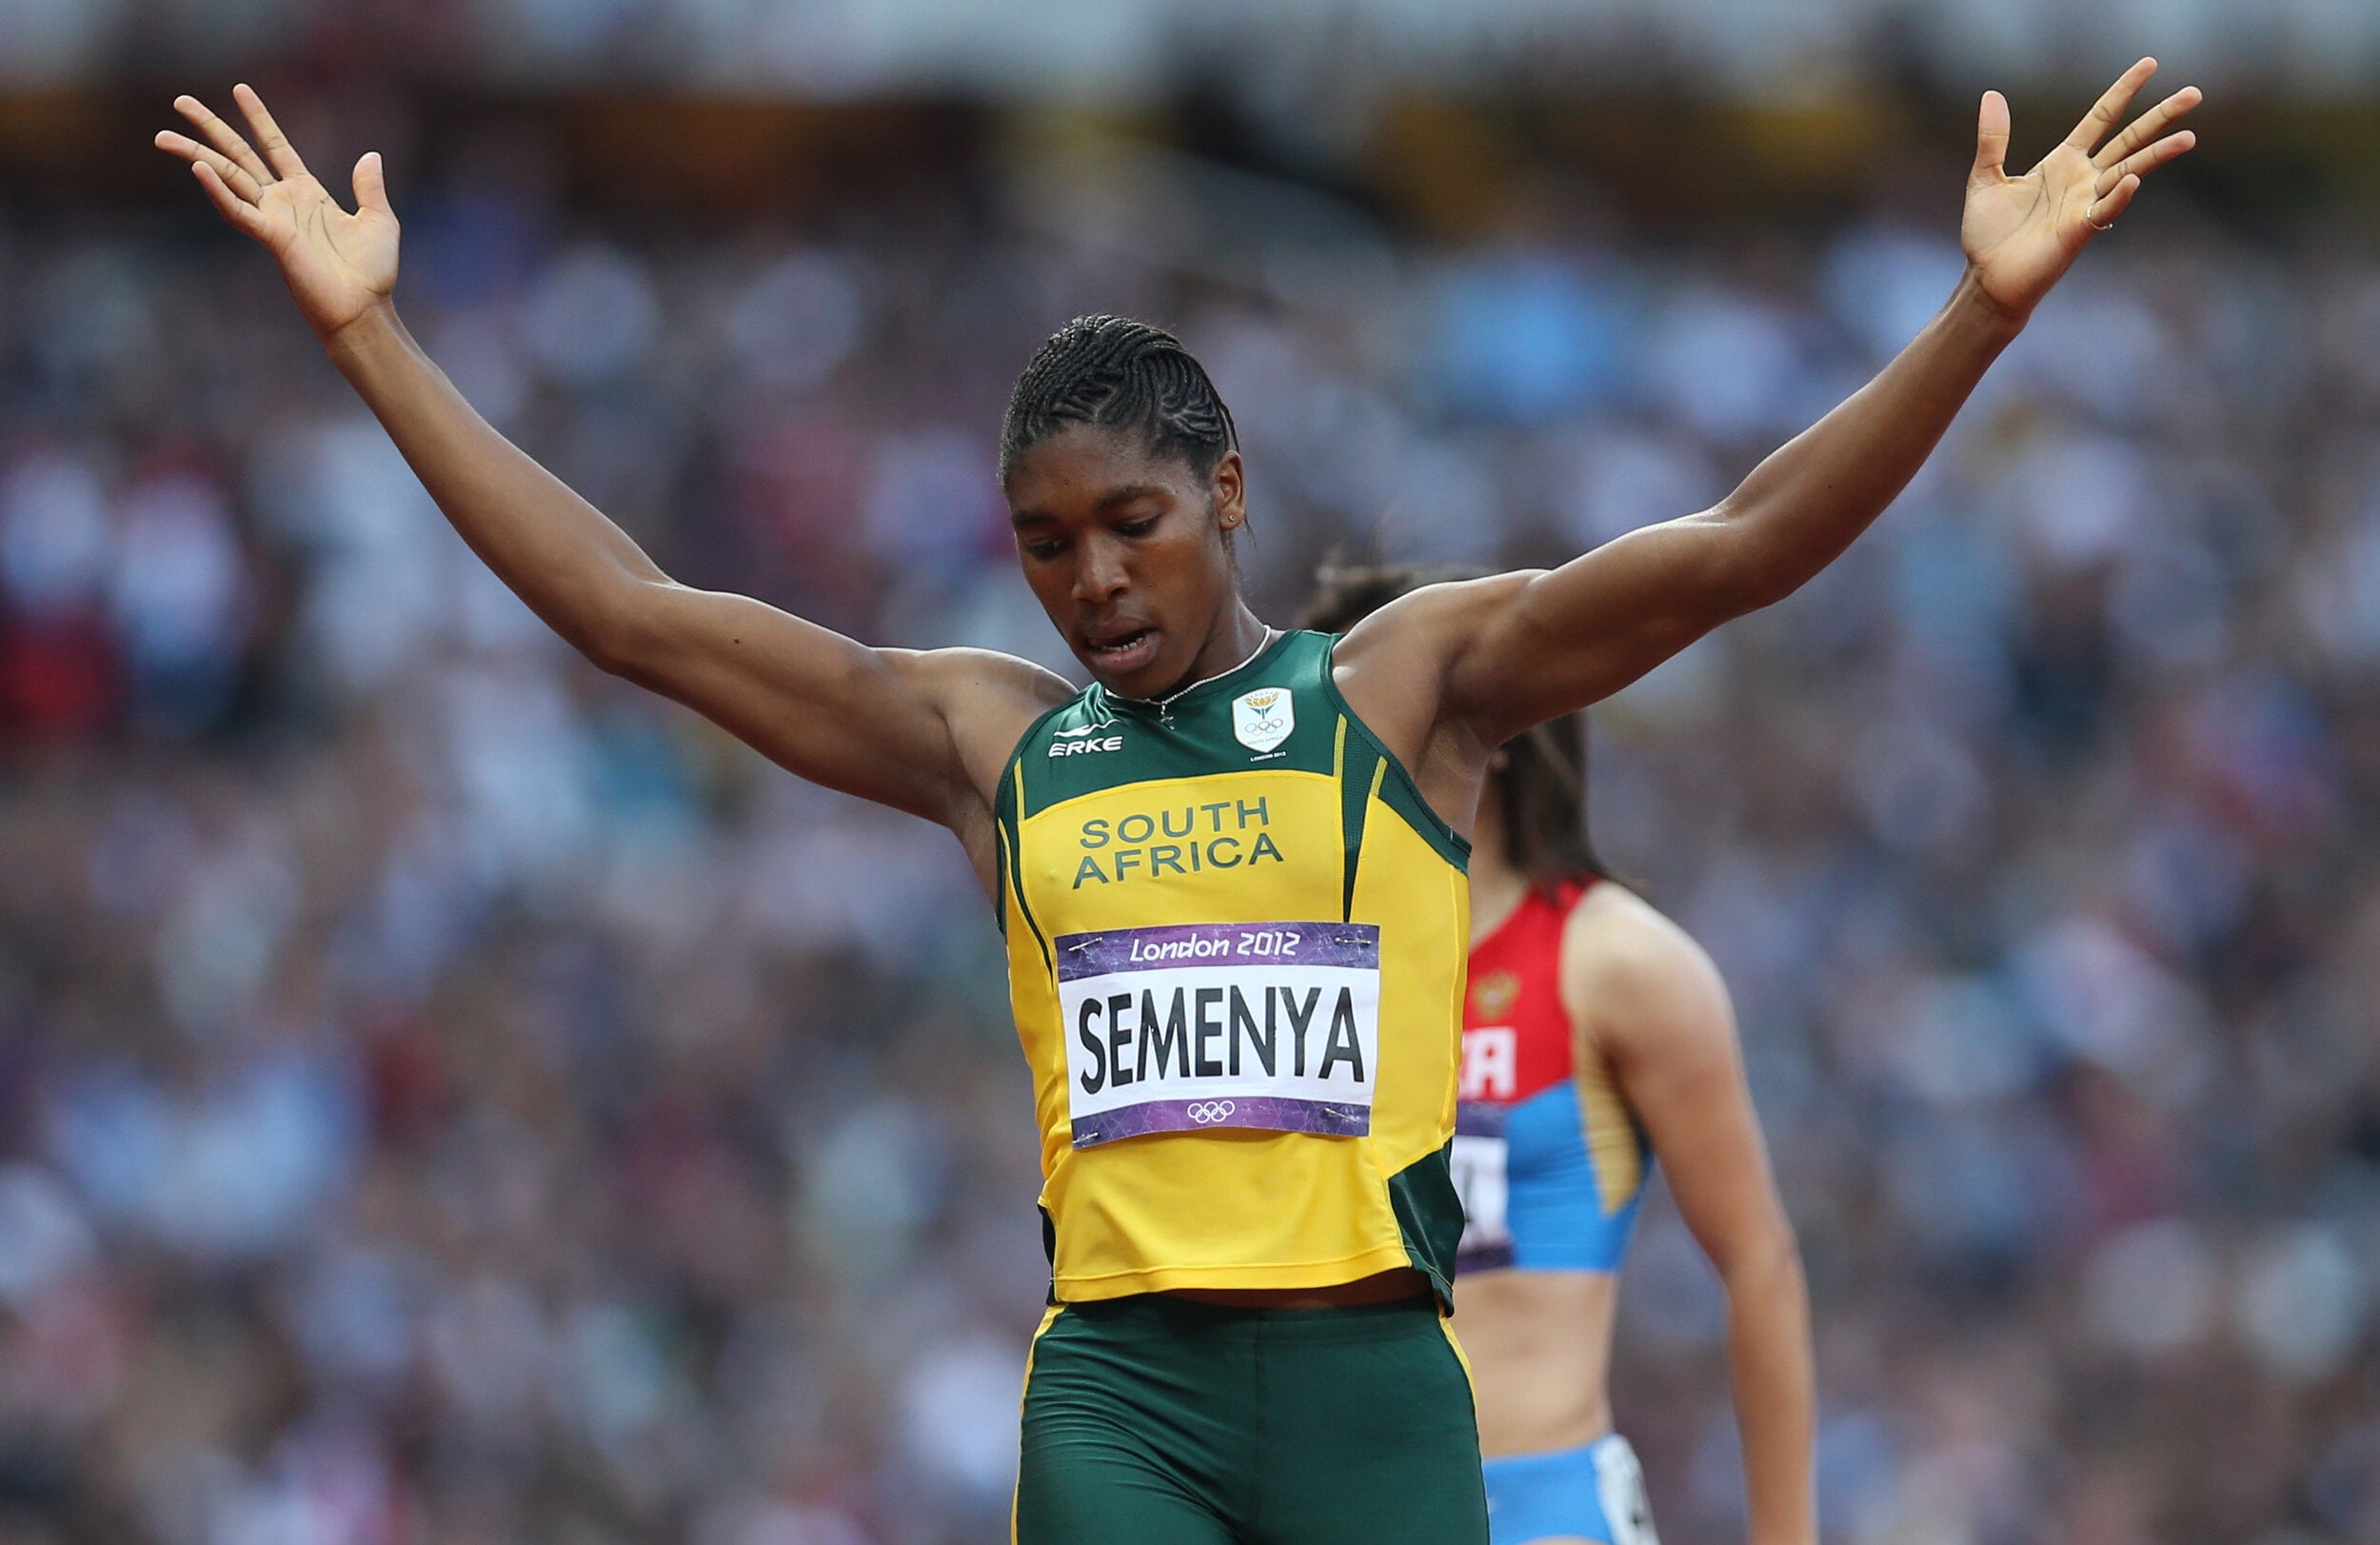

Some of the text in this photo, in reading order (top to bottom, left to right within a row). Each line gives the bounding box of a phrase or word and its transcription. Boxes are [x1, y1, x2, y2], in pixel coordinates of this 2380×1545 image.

[1048, 735, 1123, 758] ERKE
[1080, 796, 1269, 849] SOUTH
[1072, 832, 1284, 890] AFRICA
[1130, 931, 1300, 962] London 2012
[1079, 984, 1364, 1095] SEMENYA
[1458, 1026, 1517, 1099] A
